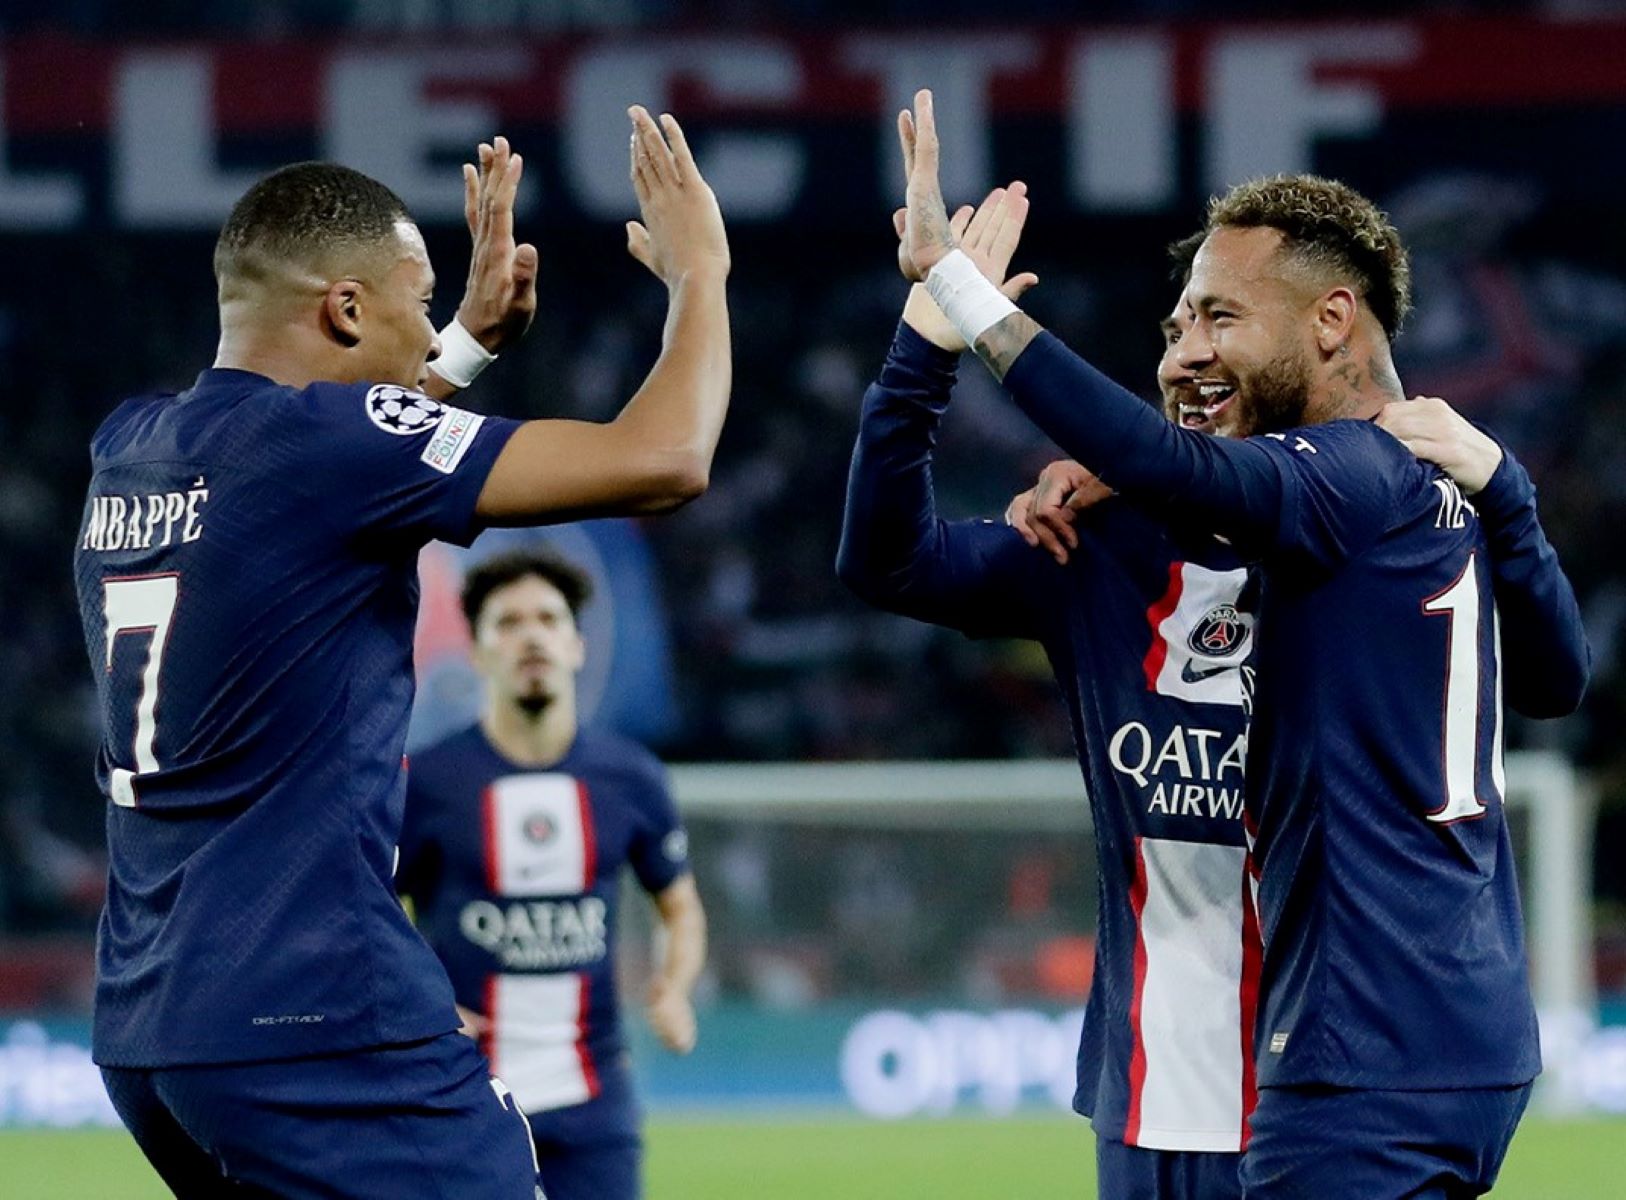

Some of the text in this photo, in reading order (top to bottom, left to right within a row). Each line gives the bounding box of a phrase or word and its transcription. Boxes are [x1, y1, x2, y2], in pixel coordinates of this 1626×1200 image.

[82, 475, 209, 551] MBAPPÉ
[102, 571, 181, 809] 7
[1421, 549, 1506, 826] 1
[459, 897, 606, 952] QATAR
